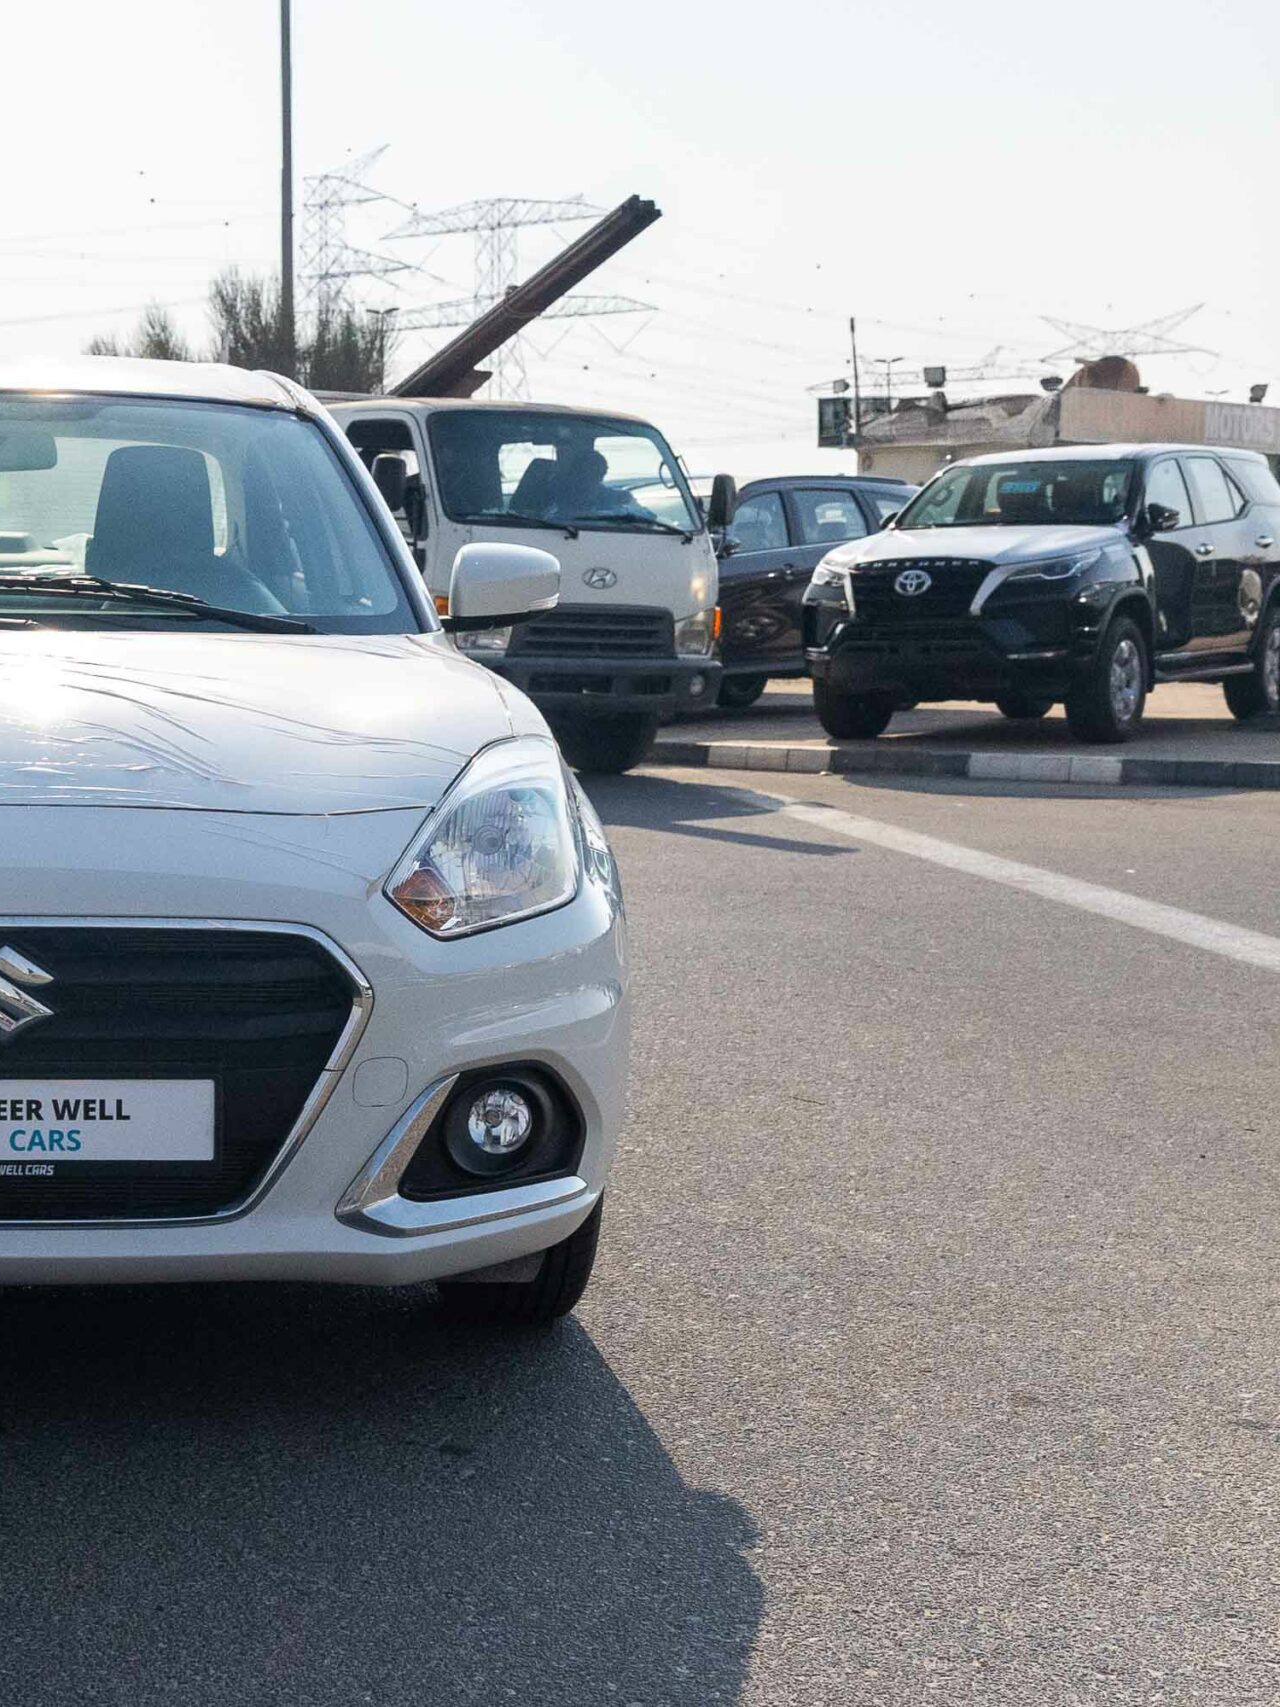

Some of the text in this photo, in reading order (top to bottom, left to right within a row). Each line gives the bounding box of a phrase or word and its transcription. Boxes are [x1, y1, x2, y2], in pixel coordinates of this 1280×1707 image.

[1205, 404, 1275, 442] MOTORS
[51, 1098, 131, 1122] WELL
[9, 1129, 82, 1152] CARS
[24, 1164, 55, 1176] CARS
